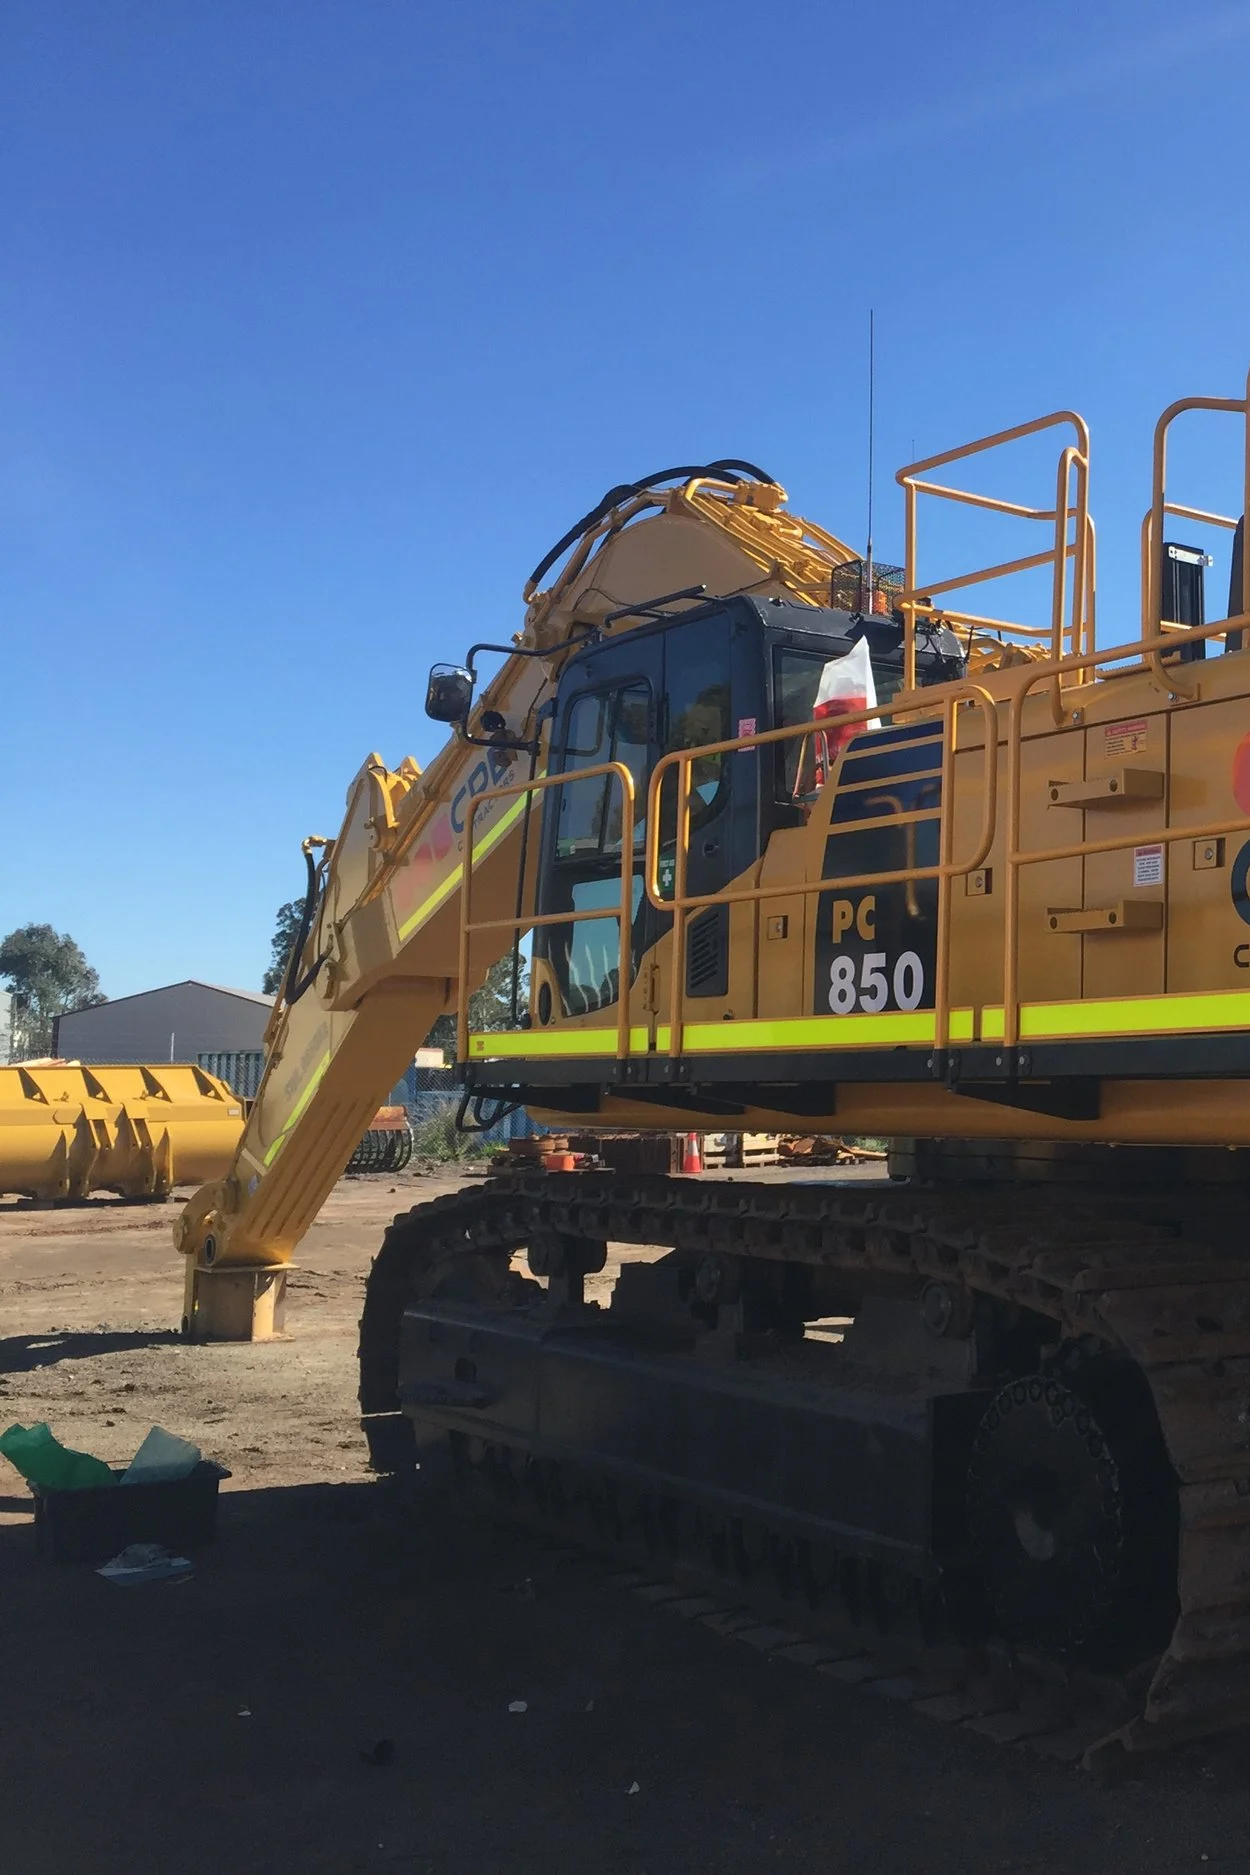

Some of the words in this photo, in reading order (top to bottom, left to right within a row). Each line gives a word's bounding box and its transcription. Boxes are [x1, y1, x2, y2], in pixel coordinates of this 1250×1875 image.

[457, 769, 515, 852] CTRACRS
[832, 895, 876, 944] PC
[828, 951, 924, 1015] 850
